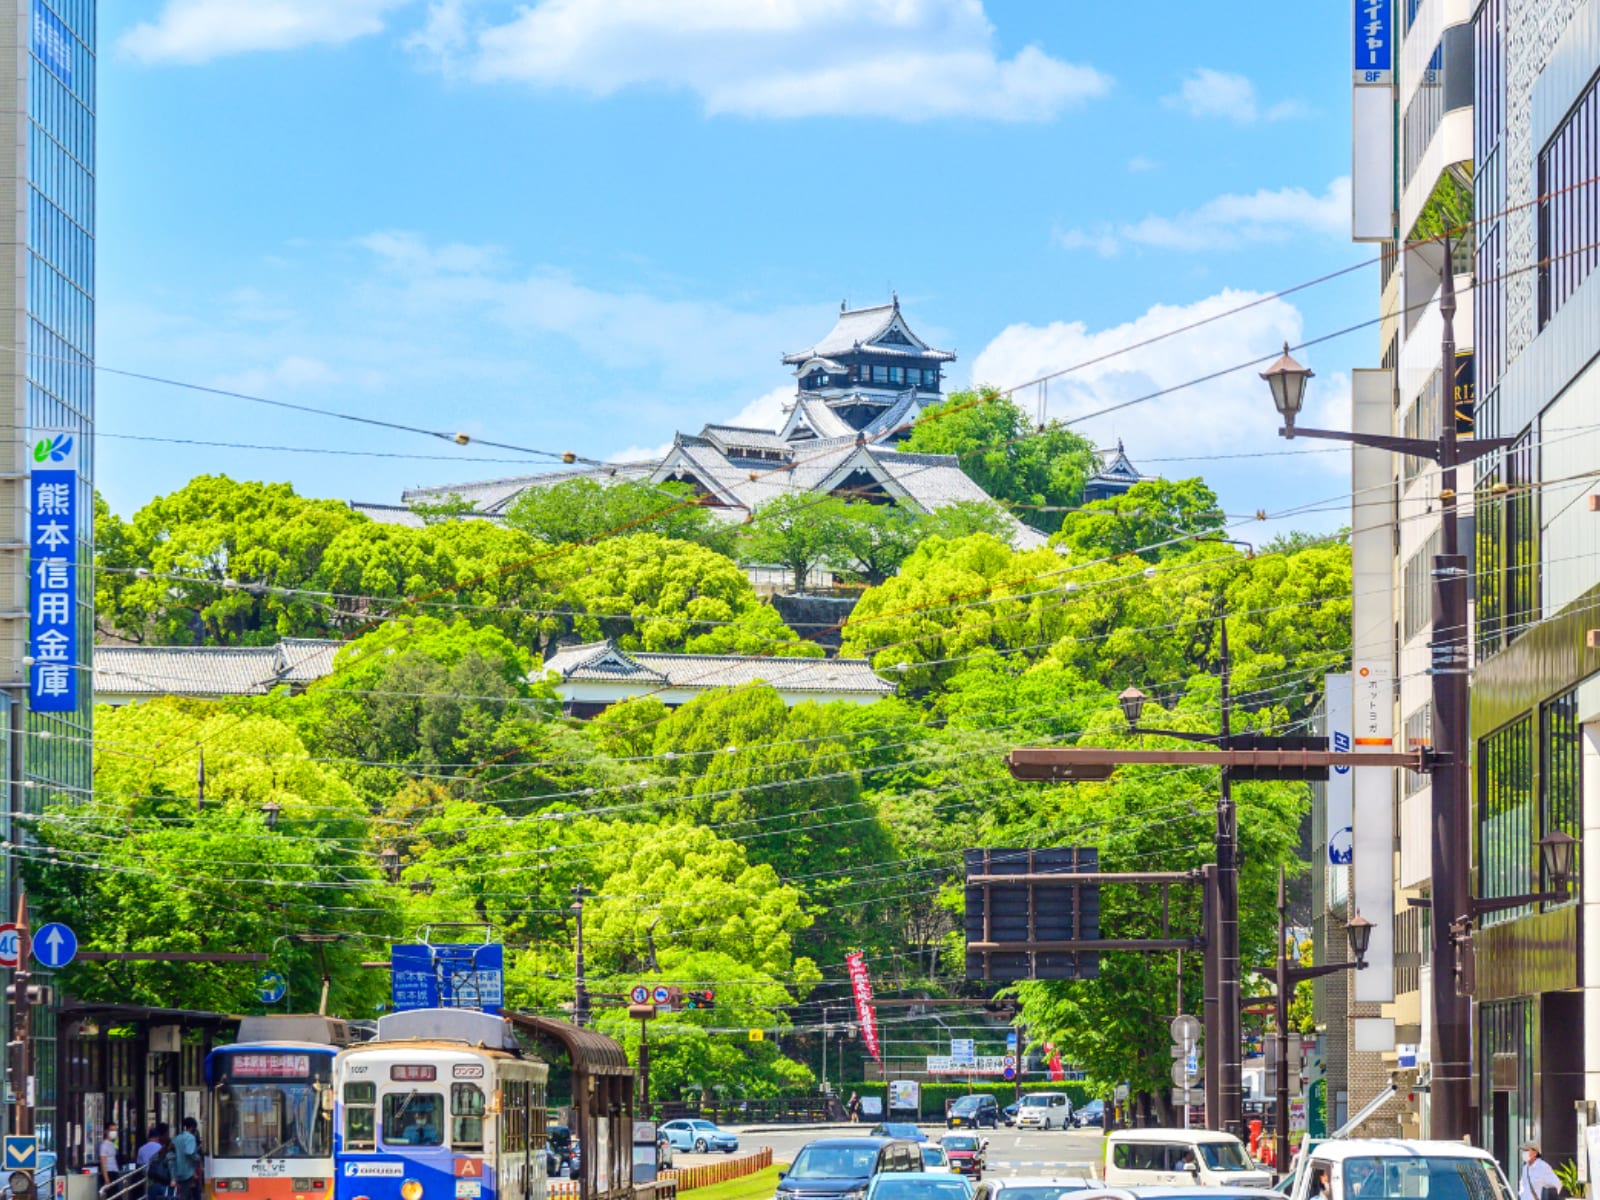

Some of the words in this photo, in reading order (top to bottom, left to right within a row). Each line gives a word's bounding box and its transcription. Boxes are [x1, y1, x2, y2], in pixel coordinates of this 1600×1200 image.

[1362, 0, 1384, 65] イチャー
[1364, 71, 1382, 82] 8F
[36, 483, 70, 697] 熊本信用金庫
[1368, 680, 1378, 734] ホットヨガ
[454, 1067, 482, 1076] ワンマン
[460, 1159, 476, 1175] A
